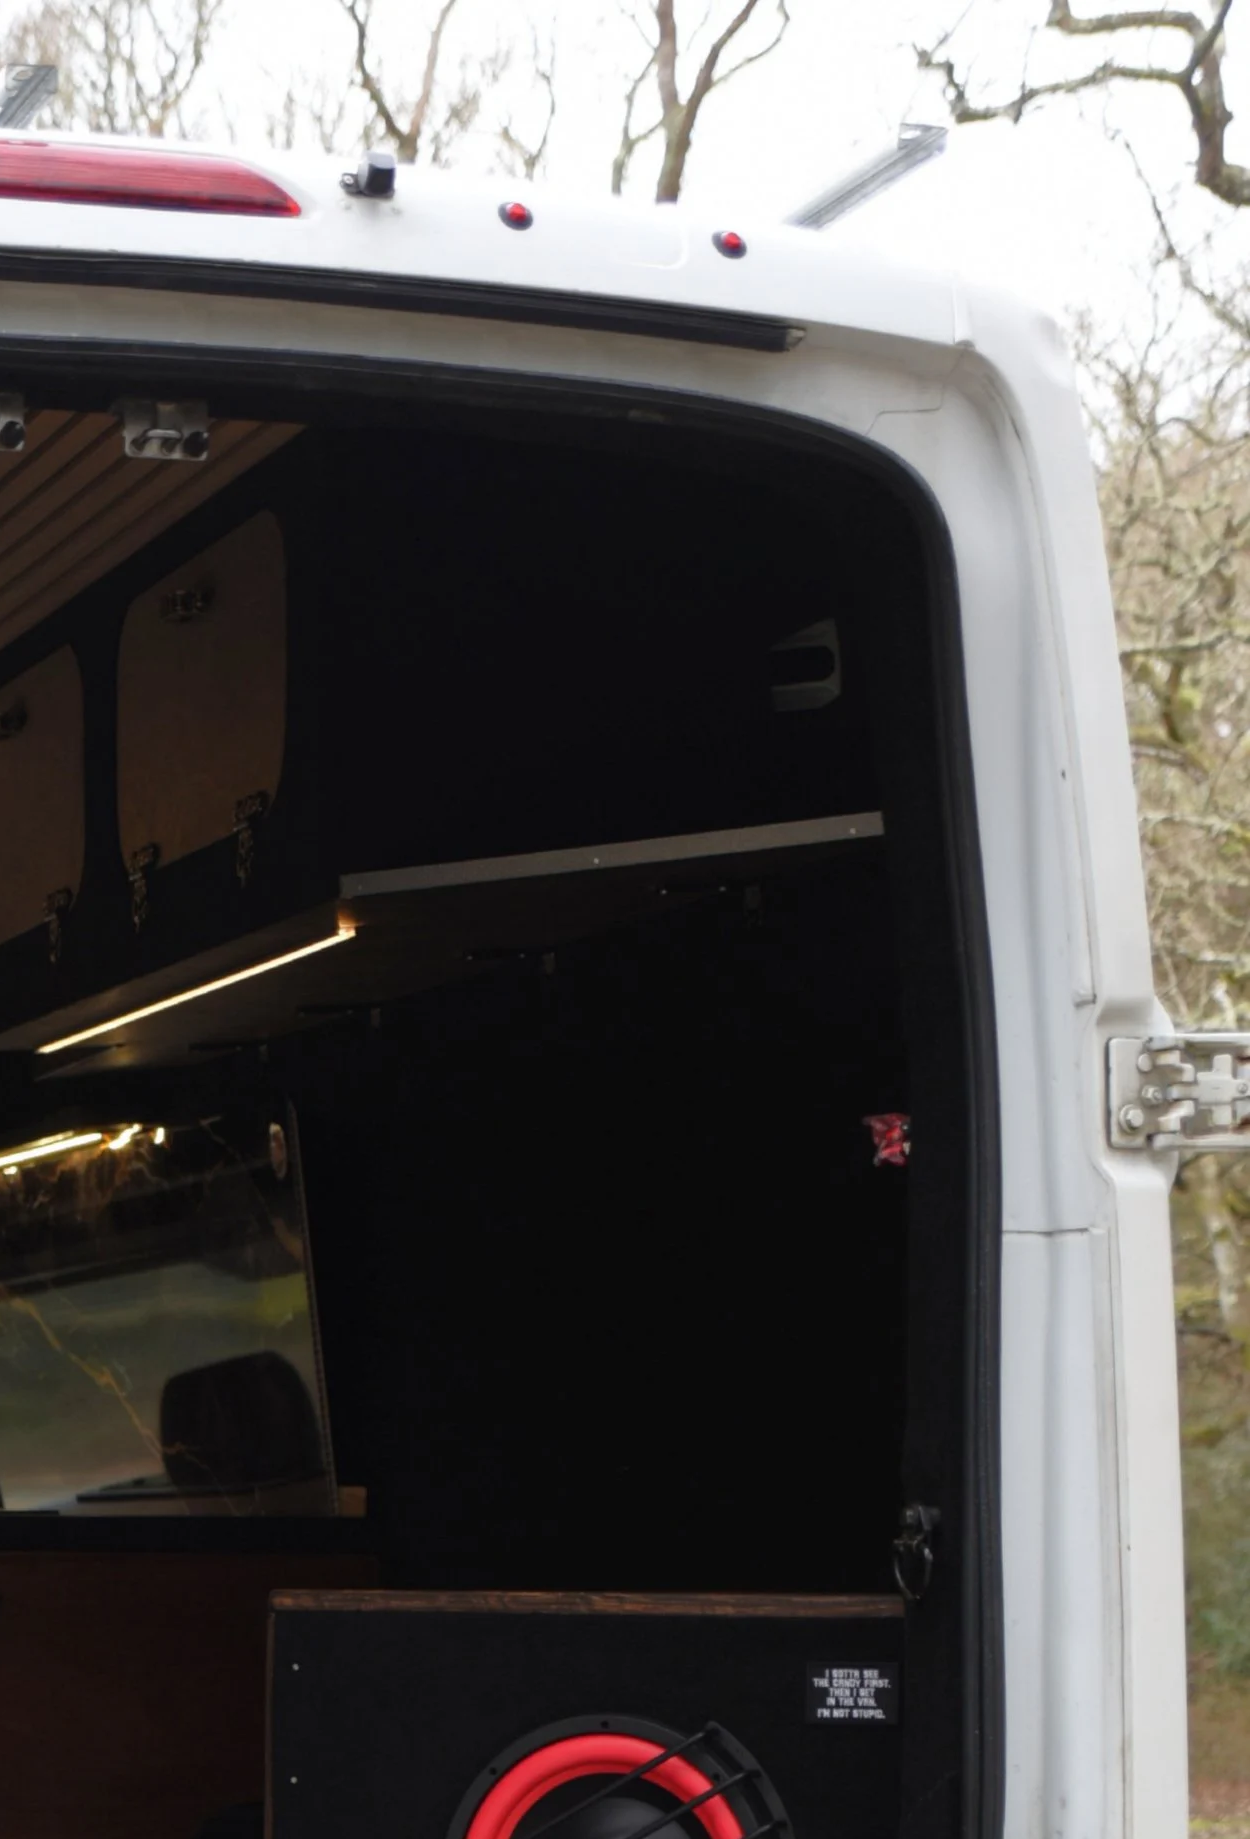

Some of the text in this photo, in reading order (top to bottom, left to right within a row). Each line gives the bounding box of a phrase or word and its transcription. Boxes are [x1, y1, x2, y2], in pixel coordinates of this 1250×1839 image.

[832, 1669, 860, 1678] GOTTA
[863, 1669, 878, 1678] SEE
[813, 1678, 829, 1687] THE
[833, 1679, 861, 1687] CANDY
[829, 1688, 850, 1697] THEN
[826, 1697, 835, 1706] IN
[838, 1697, 855, 1706] THE
[817, 1708, 830, 1718] I'M
[832, 1708, 850, 1718] NOT
